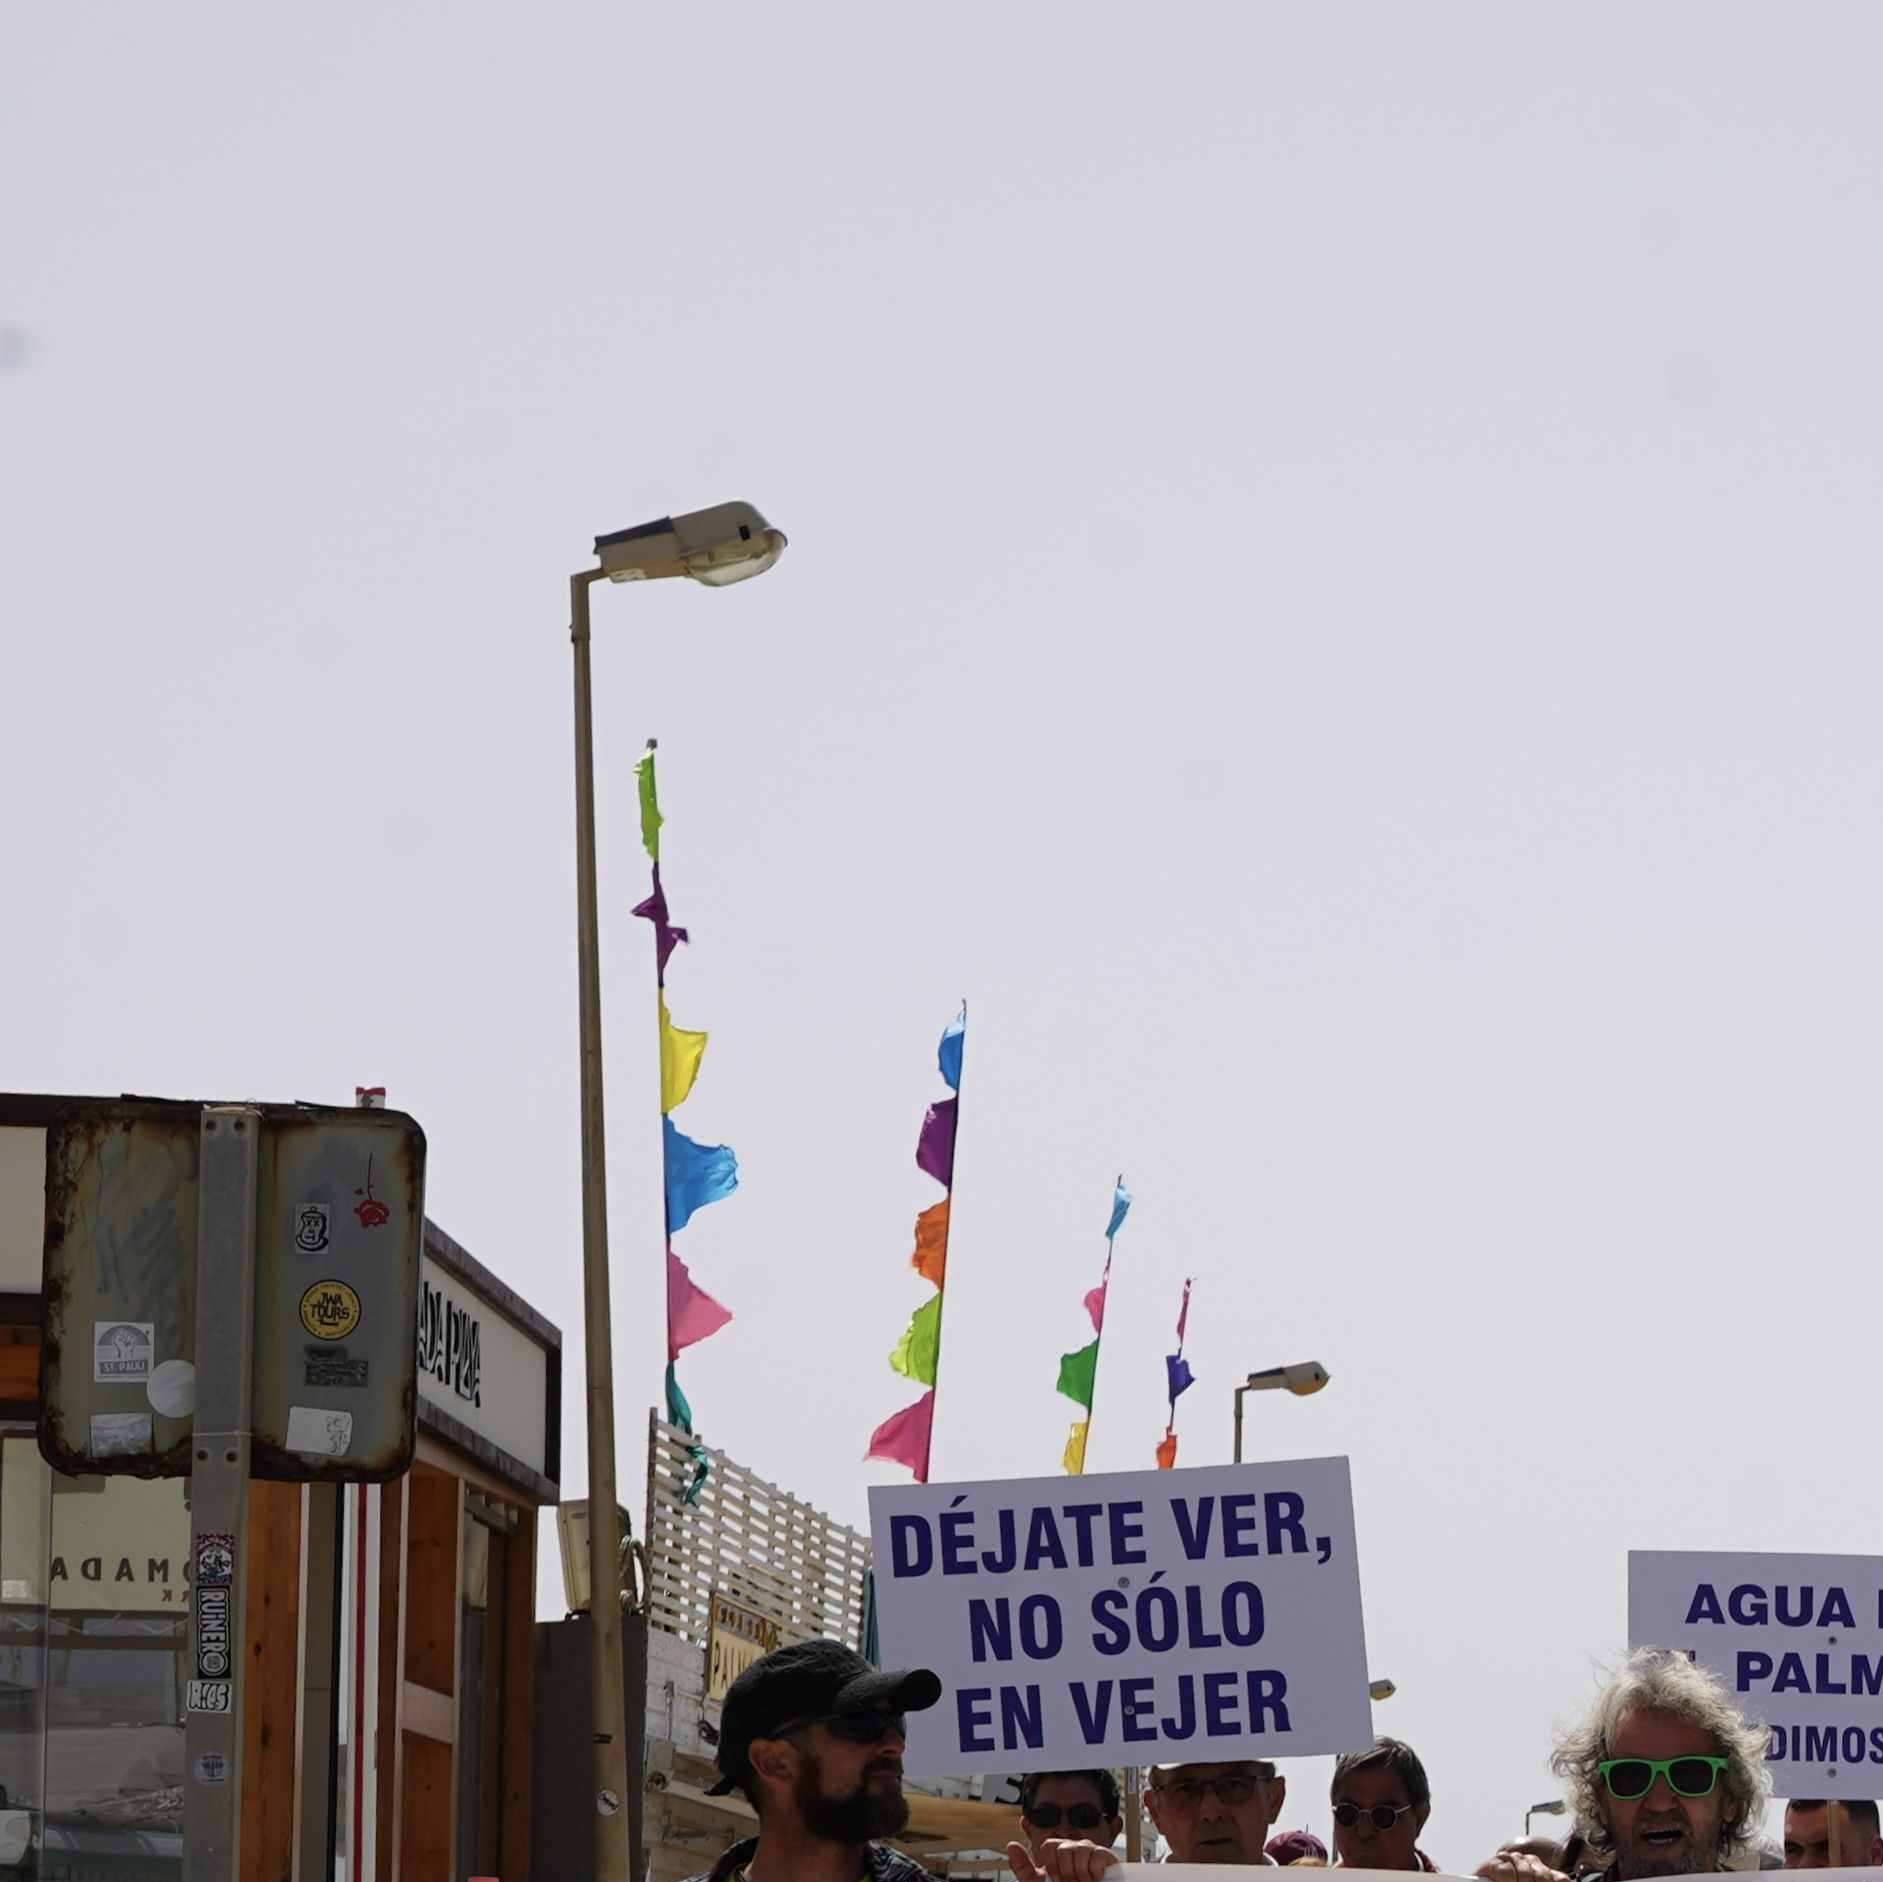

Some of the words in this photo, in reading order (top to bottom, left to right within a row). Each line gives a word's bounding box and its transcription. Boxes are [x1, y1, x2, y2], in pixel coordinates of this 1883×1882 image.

[309, 1301, 350, 1320] TOURS
[120, 1361, 145, 1372] PAULI
[890, 1496, 1146, 1578] DÉJATE
[1170, 1492, 1332, 1565] VER,
[969, 1594, 1062, 1662] NO
[1091, 1571, 1265, 1655] SÓLO
[1685, 1584, 1856, 1628] AGUA
[956, 1685, 1044, 1752] EN
[1069, 1670, 1291, 1744] VEJER
